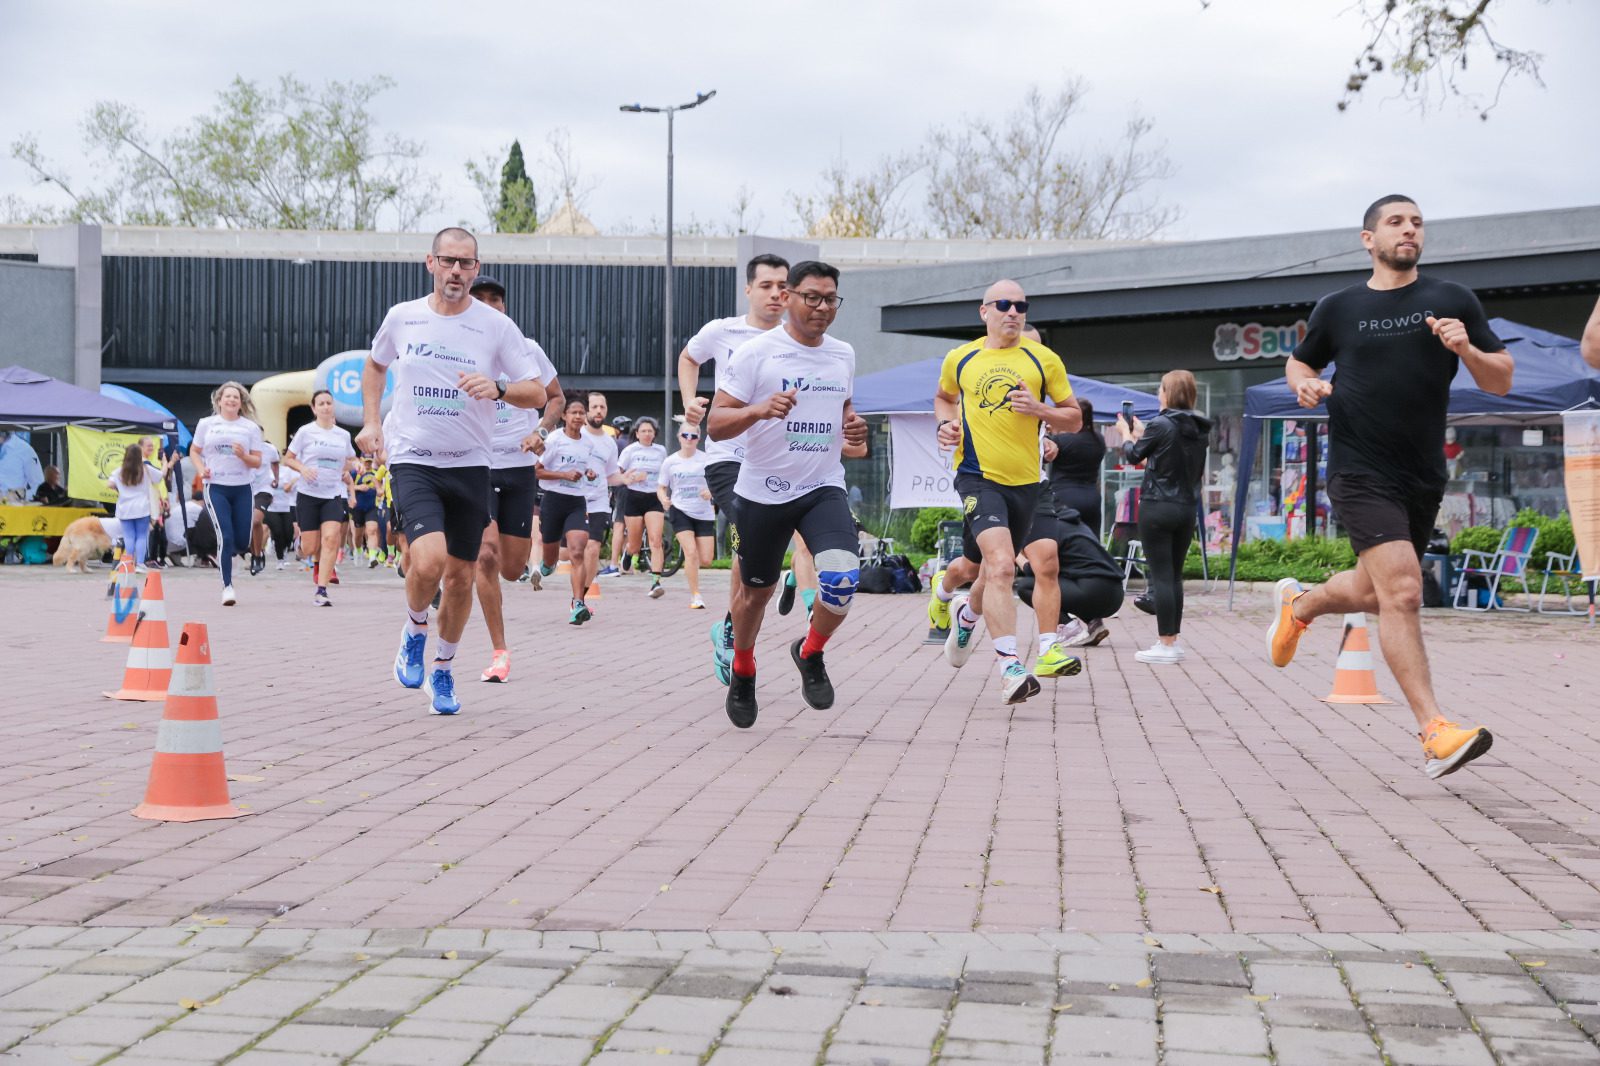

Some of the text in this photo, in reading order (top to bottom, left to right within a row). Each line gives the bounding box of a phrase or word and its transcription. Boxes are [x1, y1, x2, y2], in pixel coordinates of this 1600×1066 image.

[434, 353, 477, 366] DORNELLES
[990, 366, 1024, 381] RUNNER
[413, 385, 459, 399] CORRIDA
[417, 404, 459, 417] Solidária
[786, 421, 832, 434] CORRIDA
[911, 475, 956, 493] PRO
